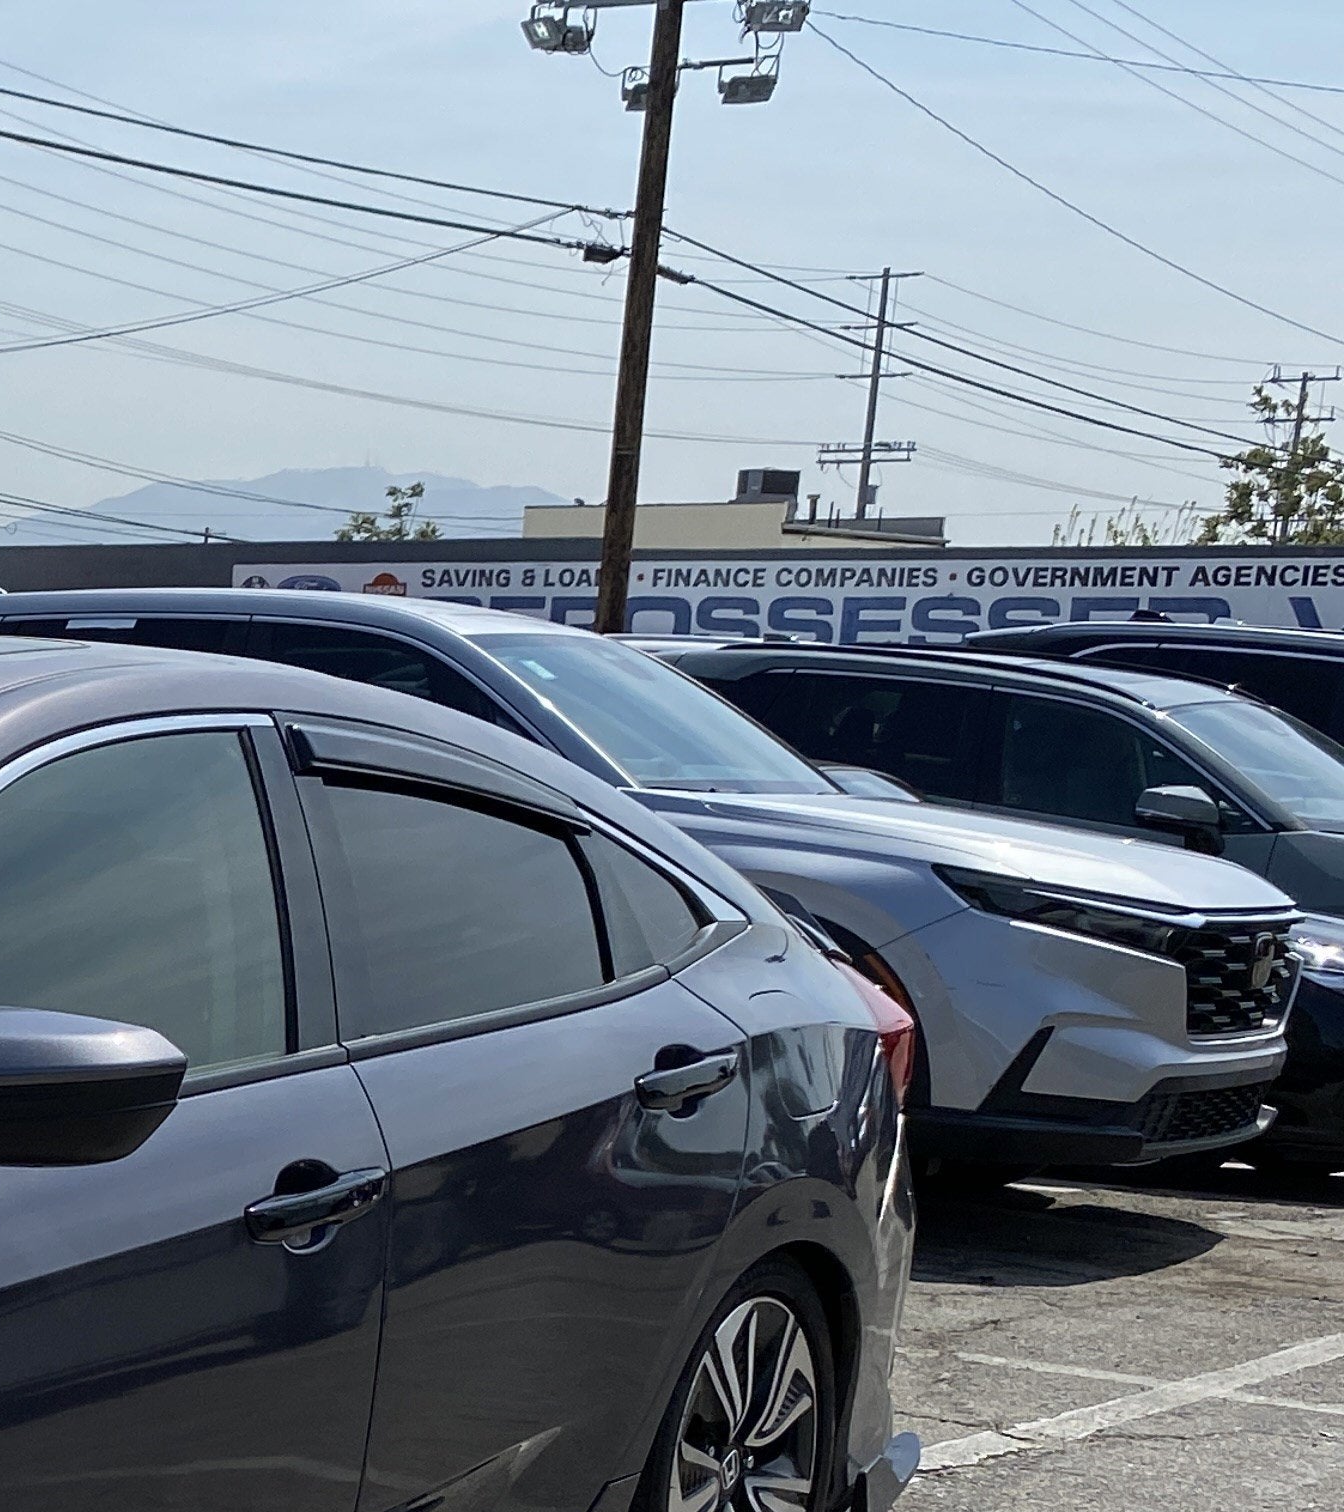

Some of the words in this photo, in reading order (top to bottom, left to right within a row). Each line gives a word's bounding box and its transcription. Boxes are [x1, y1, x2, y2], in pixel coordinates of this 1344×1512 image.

[421, 568, 511, 588] SAVING
[521, 568, 536, 588] &
[543, 568, 601, 588] LOA
[651, 567, 767, 588] FINANCE
[775, 567, 938, 588] COMPANIES
[966, 566, 1180, 588] GOVERNMENT
[1189, 564, 1344, 588] AGENCIES
